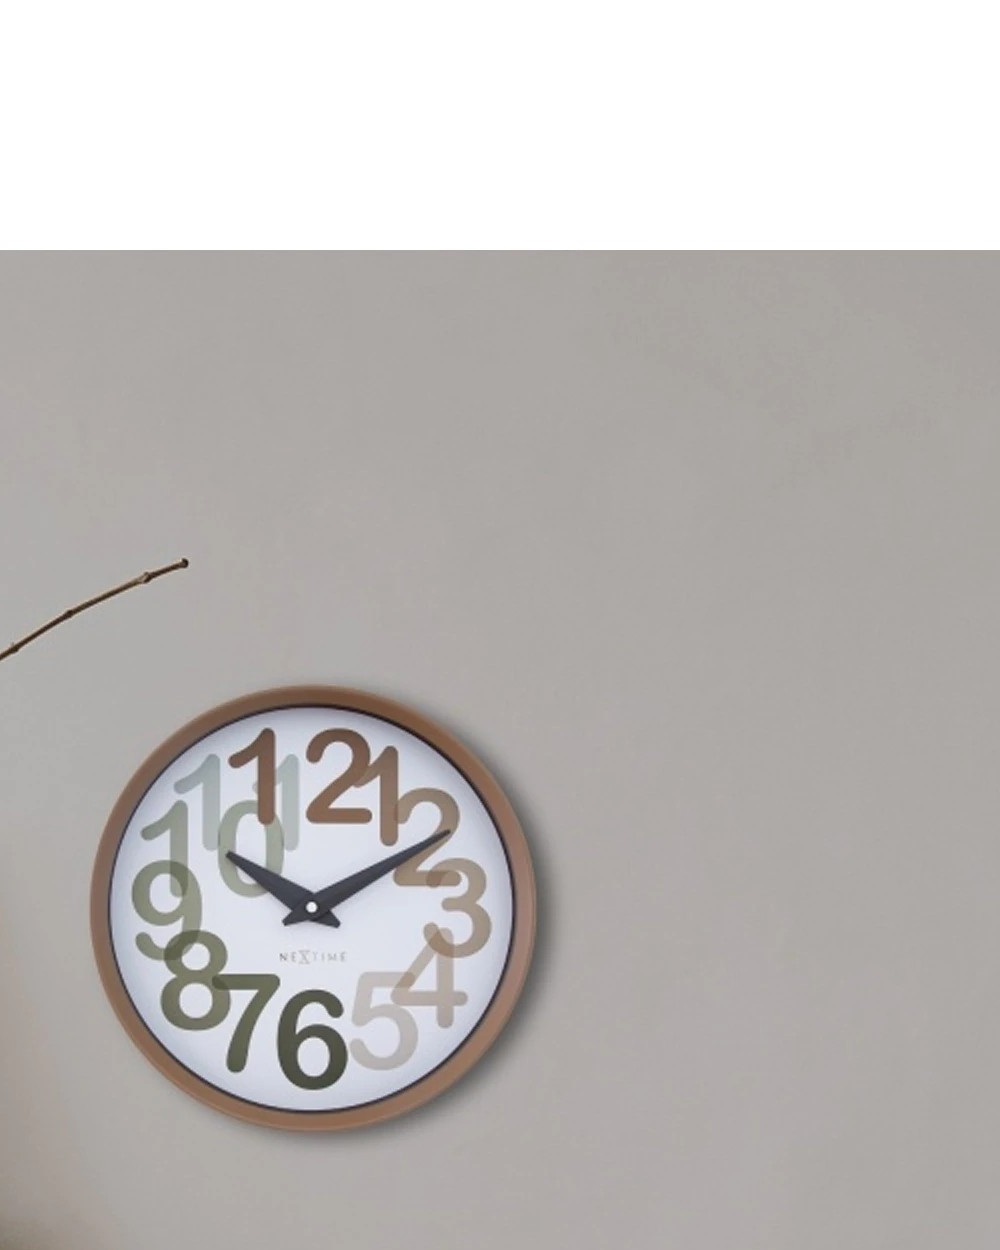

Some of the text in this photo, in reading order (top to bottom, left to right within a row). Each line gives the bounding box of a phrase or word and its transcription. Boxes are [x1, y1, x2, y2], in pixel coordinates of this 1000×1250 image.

[173, 753, 300, 852] 11
[228, 727, 373, 826] 12
[352, 745, 399, 847] 1
[140, 799, 285, 898] 10
[394, 787, 460, 887] 2
[131, 859, 202, 961] 9
[279, 949, 347, 965] NEXTIME
[425, 857, 493, 958] 3
[160, 929, 231, 1032] 8
[211, 973, 281, 1074] 7
[349, 971, 419, 1071] 5
[390, 927, 469, 1029] 4
[277, 988, 348, 1091] 6
